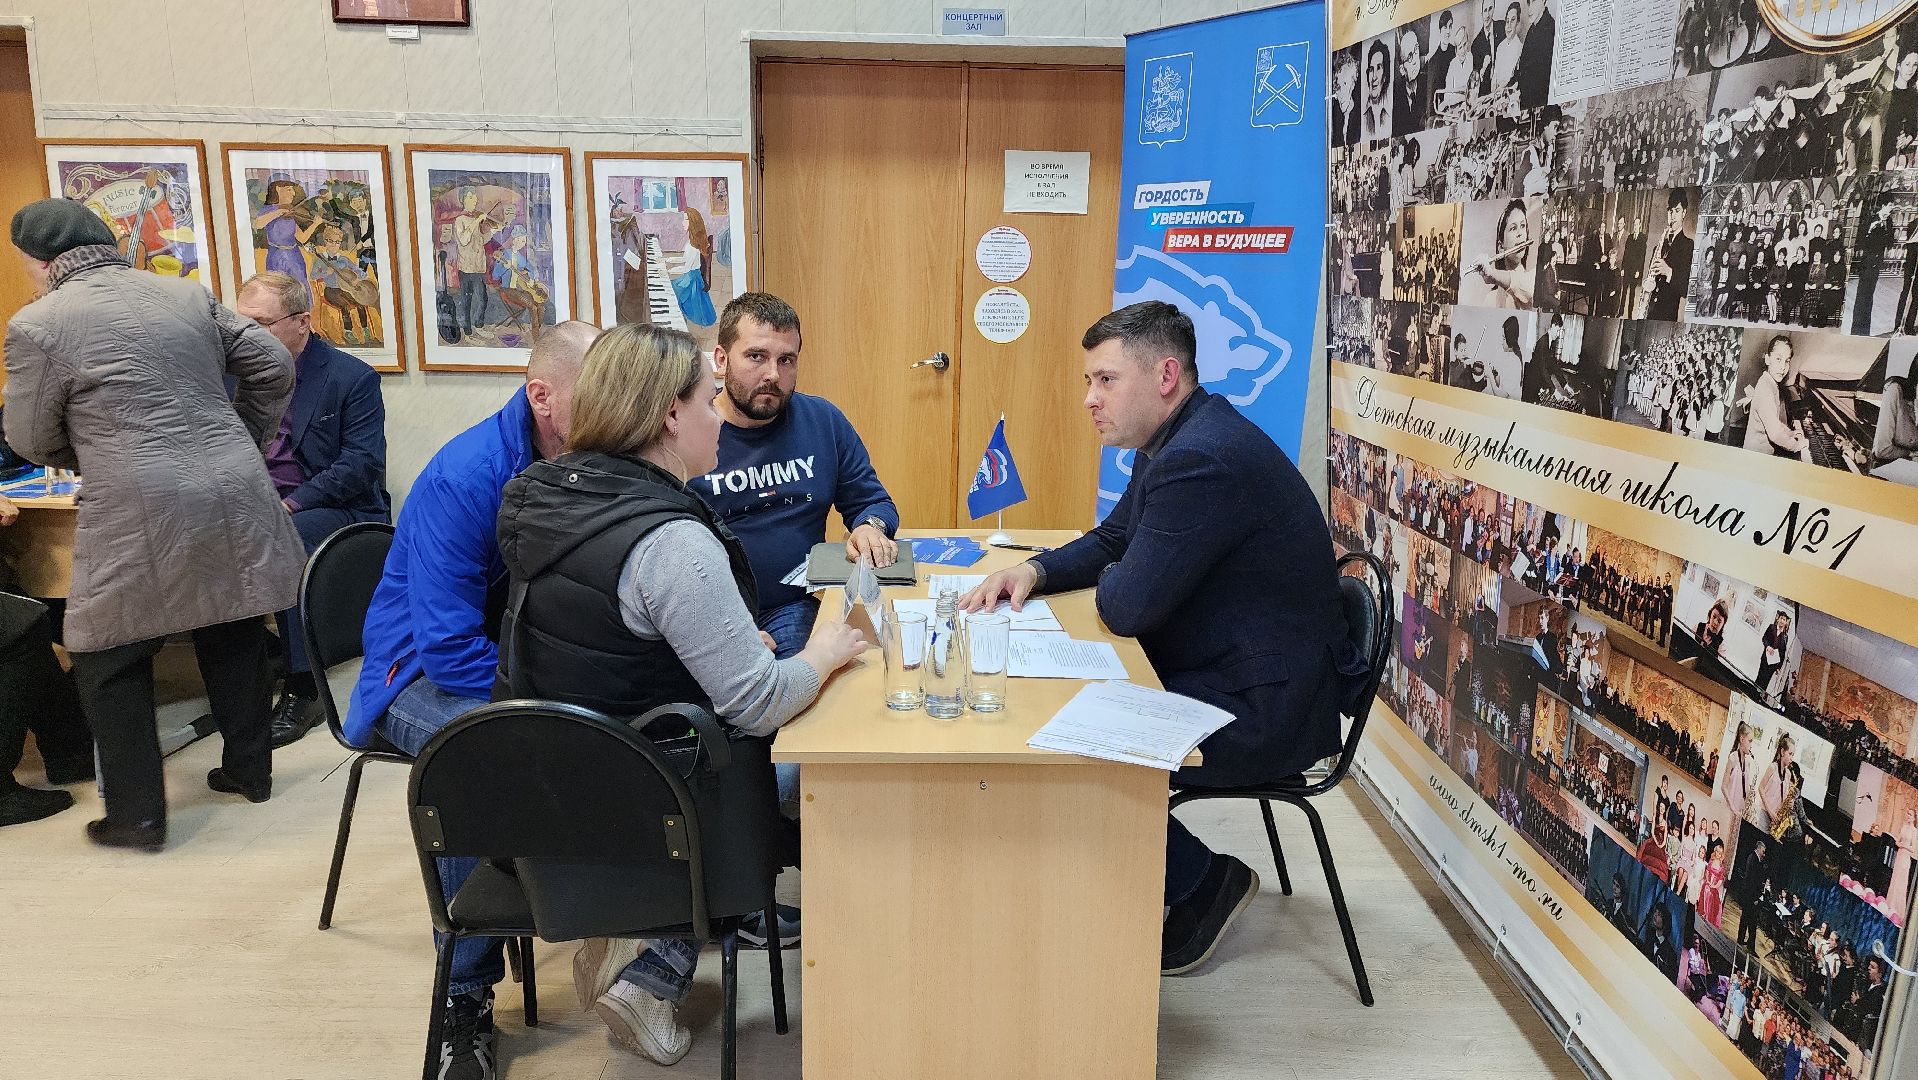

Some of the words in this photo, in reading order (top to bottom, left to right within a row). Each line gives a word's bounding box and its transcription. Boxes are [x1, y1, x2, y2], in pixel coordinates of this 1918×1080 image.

[945, 11, 1003, 22] КОНЦЕРТНЫЙ
[965, 22, 982, 31] ЗАЛ
[1036, 191, 1067, 199] ВХОДИТЬ
[1138, 188, 1204, 205] ГОРДОСТЬ
[1151, 210, 1245, 225] УВЕРЕННОСТЬ
[1167, 234, 1200, 248] ВЕРА
[1202, 234, 1213, 248] В
[1214, 233, 1287, 250] БУДУЩЕЕ
[1357, 375, 1437, 440] Детская
[1438, 421, 1613, 496] музыкальная
[1619, 462, 1746, 537] школа
[705, 455, 814, 496] TOMMY
